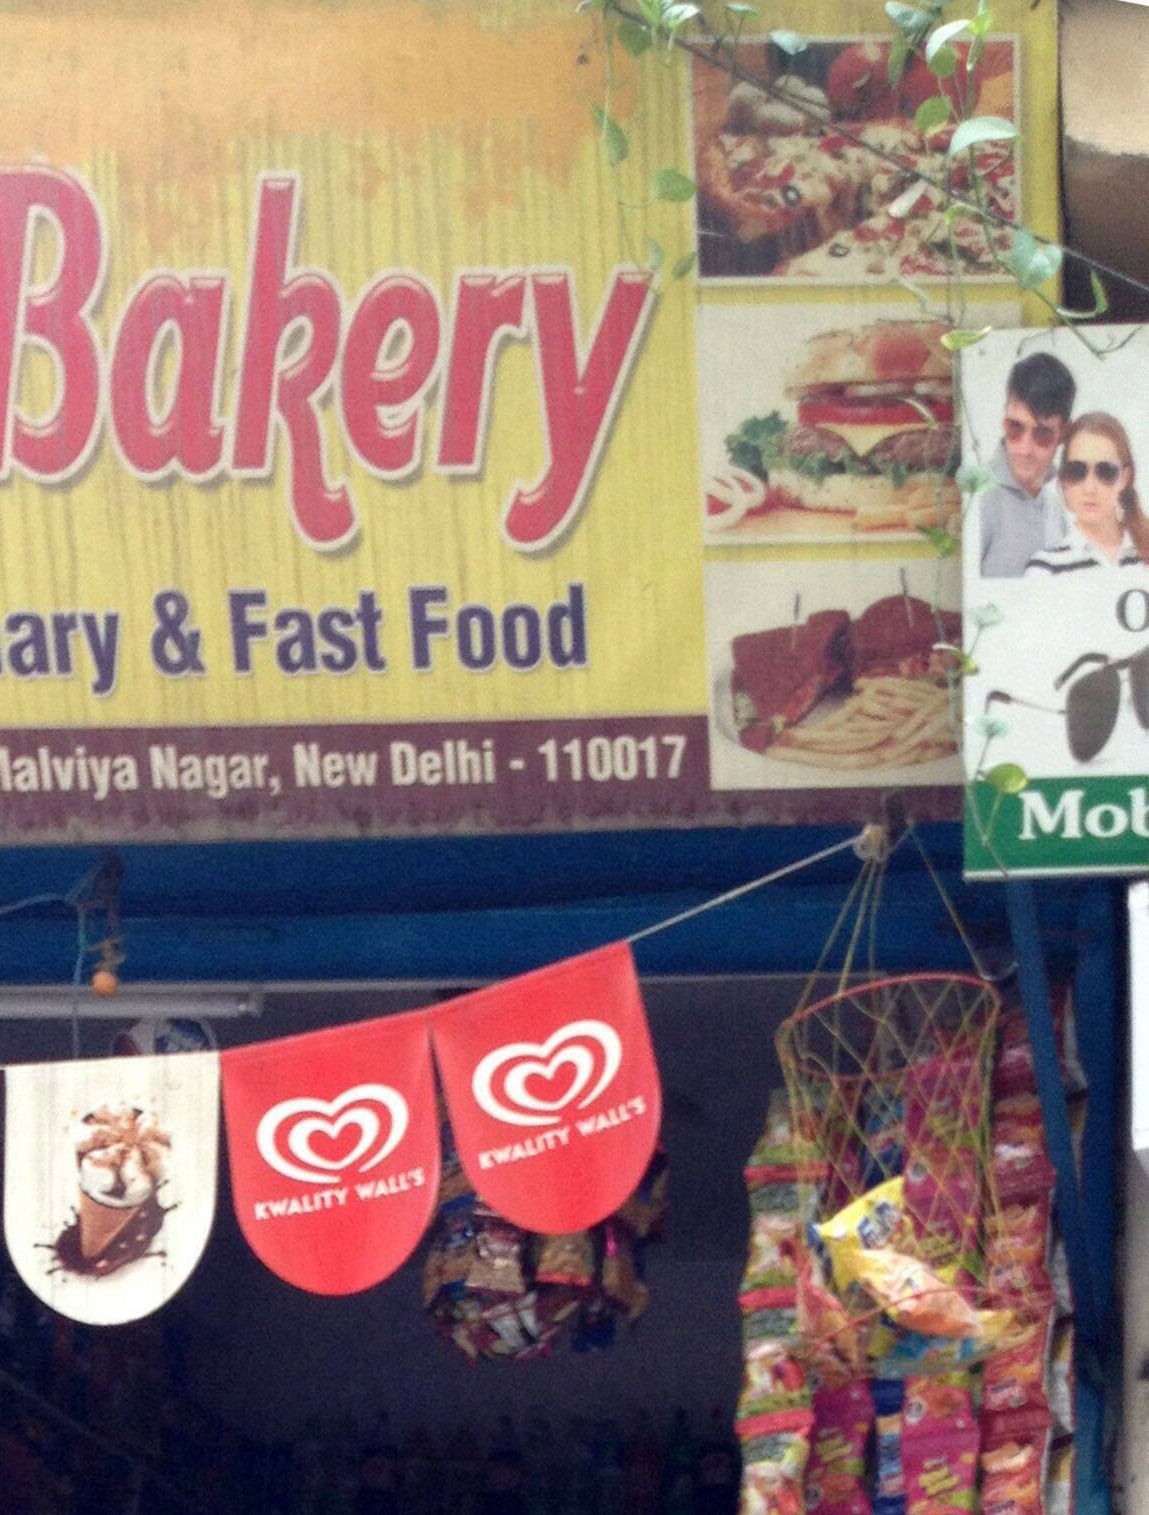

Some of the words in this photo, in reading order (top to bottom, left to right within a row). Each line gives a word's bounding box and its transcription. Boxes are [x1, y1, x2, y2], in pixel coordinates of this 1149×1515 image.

[151, 589, 206, 676] &
[228, 588, 387, 674] Fast
[409, 583, 588, 670] Food
[148, 743, 282, 798] Nagar,
[292, 741, 378, 788] New
[389, 739, 496, 786] Delhi
[537, 734, 687, 782] 110017
[477, 1126, 571, 1171] KWALITY
[253, 1187, 349, 1222] KWALITY
